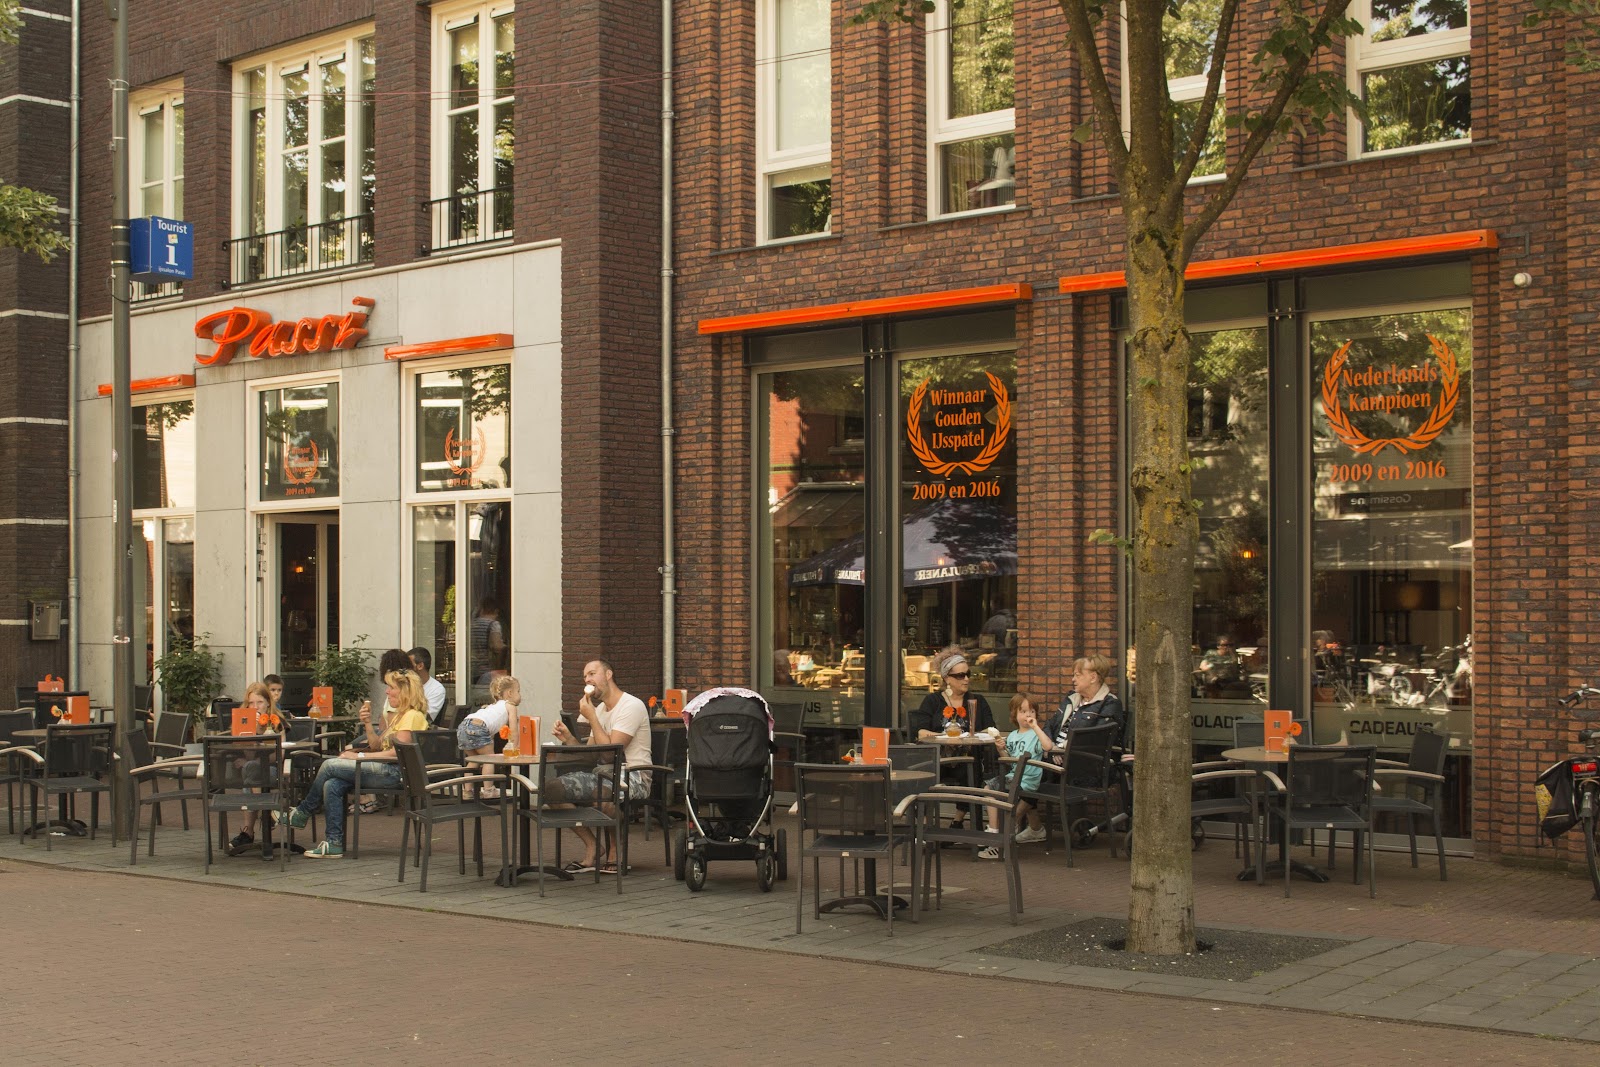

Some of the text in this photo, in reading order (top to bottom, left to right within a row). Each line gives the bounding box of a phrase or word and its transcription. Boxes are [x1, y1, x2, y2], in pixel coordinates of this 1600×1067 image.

[157, 219, 188, 234] Tourist
[194, 296, 376, 366] Passi
[1343, 363, 1437, 387] Nederlands
[930, 388, 987, 406] Winnaar
[1349, 391, 1432, 414] Kampioen
[935, 408, 982, 427] Gouden
[1329, 460, 1446, 482] 2009 en 2016
[912, 481, 1001, 501] 2009 en 2016
